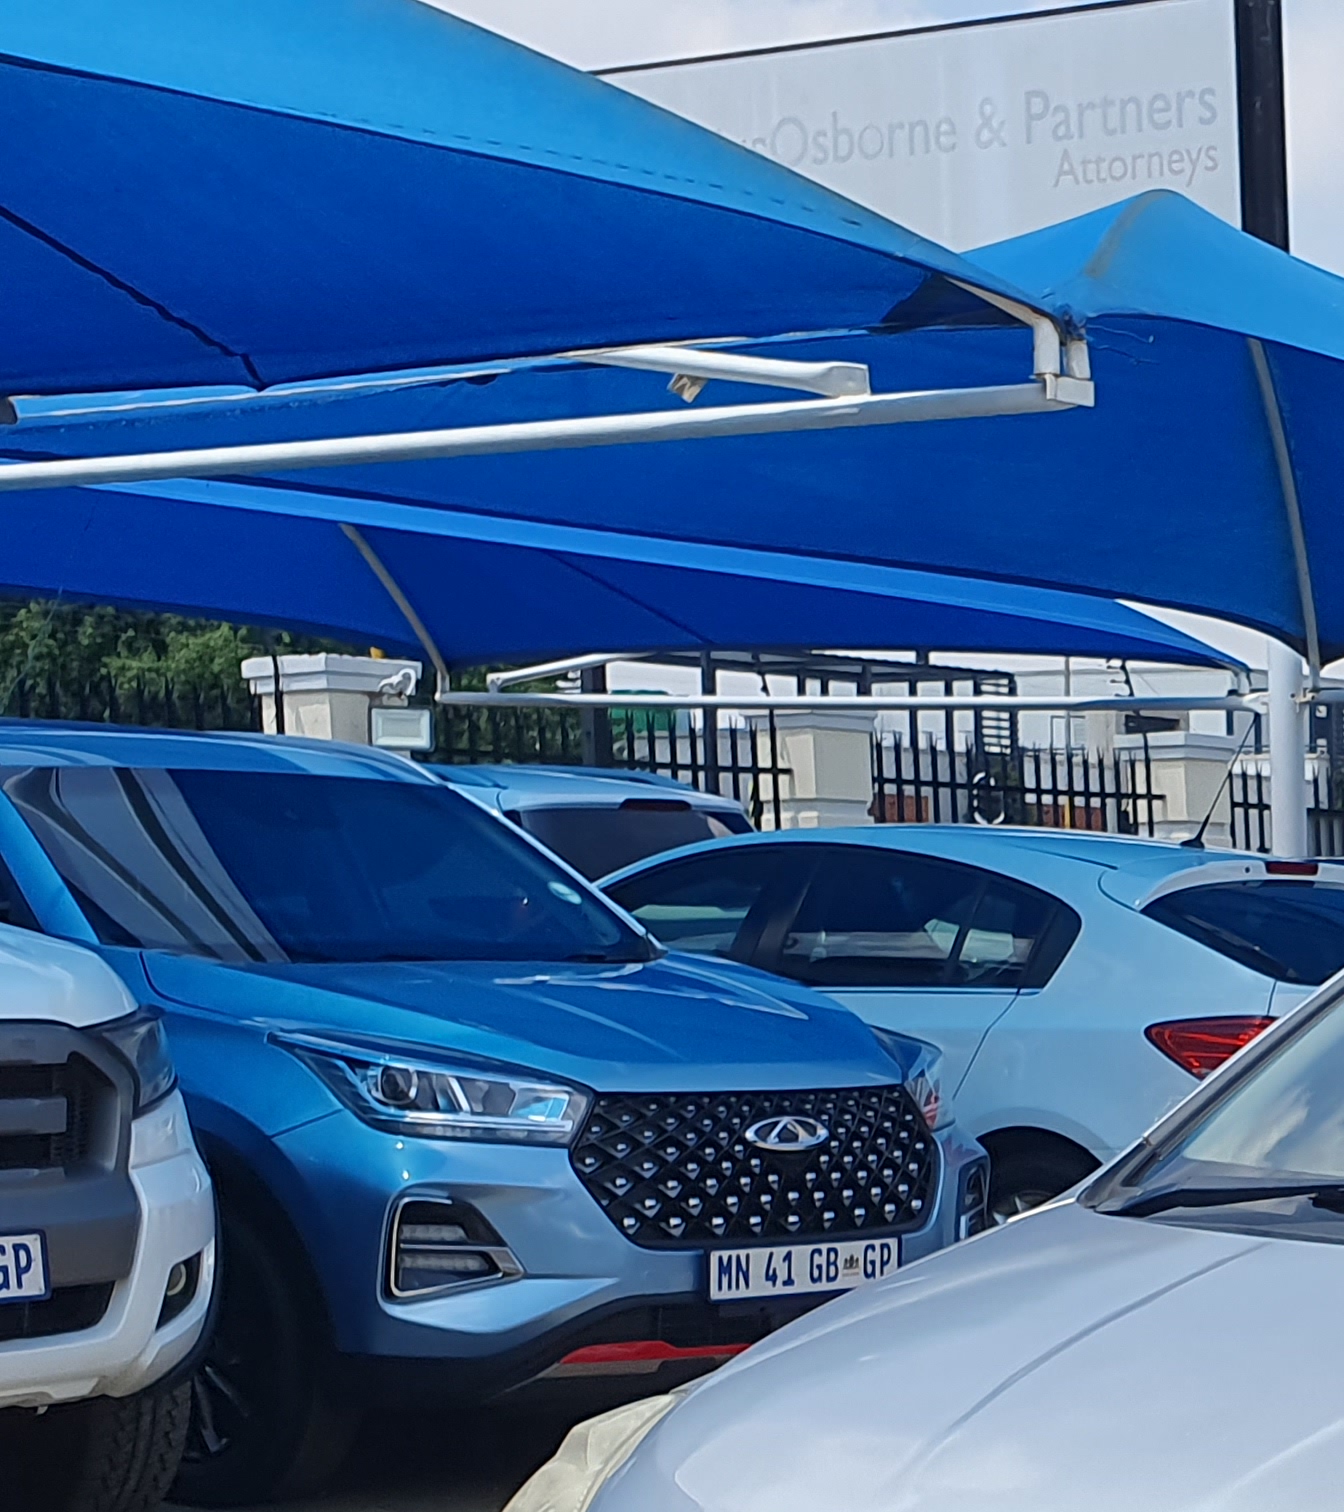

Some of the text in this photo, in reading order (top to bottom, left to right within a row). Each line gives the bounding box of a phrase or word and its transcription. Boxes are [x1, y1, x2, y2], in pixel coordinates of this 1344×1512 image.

[973, 96, 1007, 150] &
[1023, 86, 1218, 145] Partners
[1053, 144, 1219, 188] Attorneys
[717, 1242, 892, 1292] MN 41 GB GP
